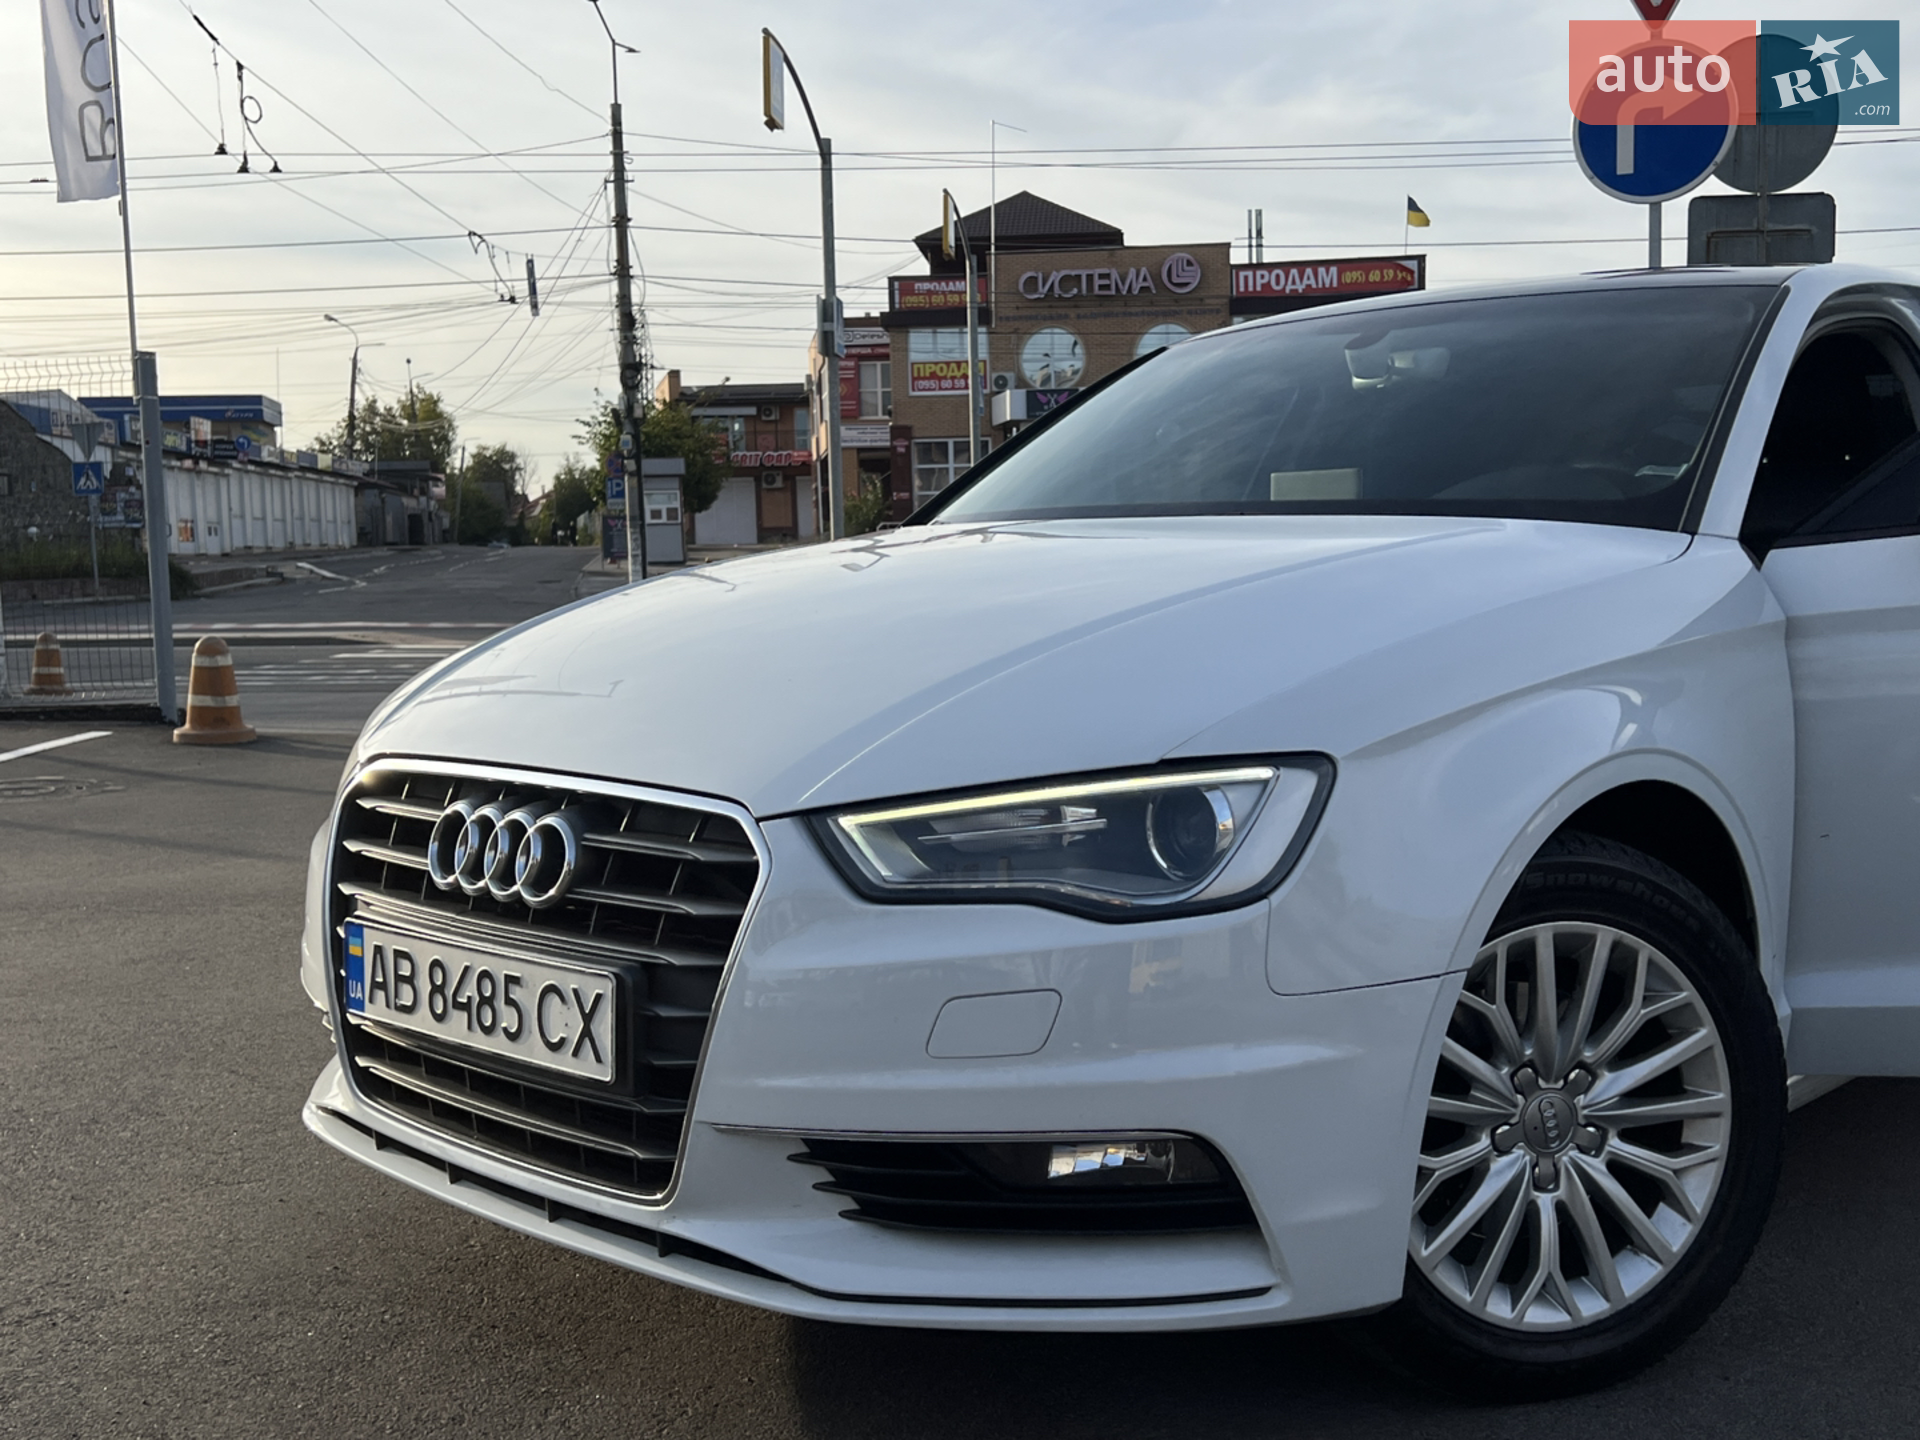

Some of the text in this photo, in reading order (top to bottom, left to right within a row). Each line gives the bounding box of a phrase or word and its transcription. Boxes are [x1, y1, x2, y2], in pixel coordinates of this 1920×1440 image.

[914, 281, 966, 294] ПРОДАМ
[1018, 267, 1157, 300] СИСТЕМА
[1239, 267, 1338, 294] ПРОДАМ
[1341, 272, 1366, 284] (095)
[1369, 270, 1381, 283] 60
[1383, 269, 1394, 282] 59
[914, 378, 966, 391] (095) 60 59
[349, 979, 363, 1000] UA
[368, 942, 605, 1065] AB 8485 CX
